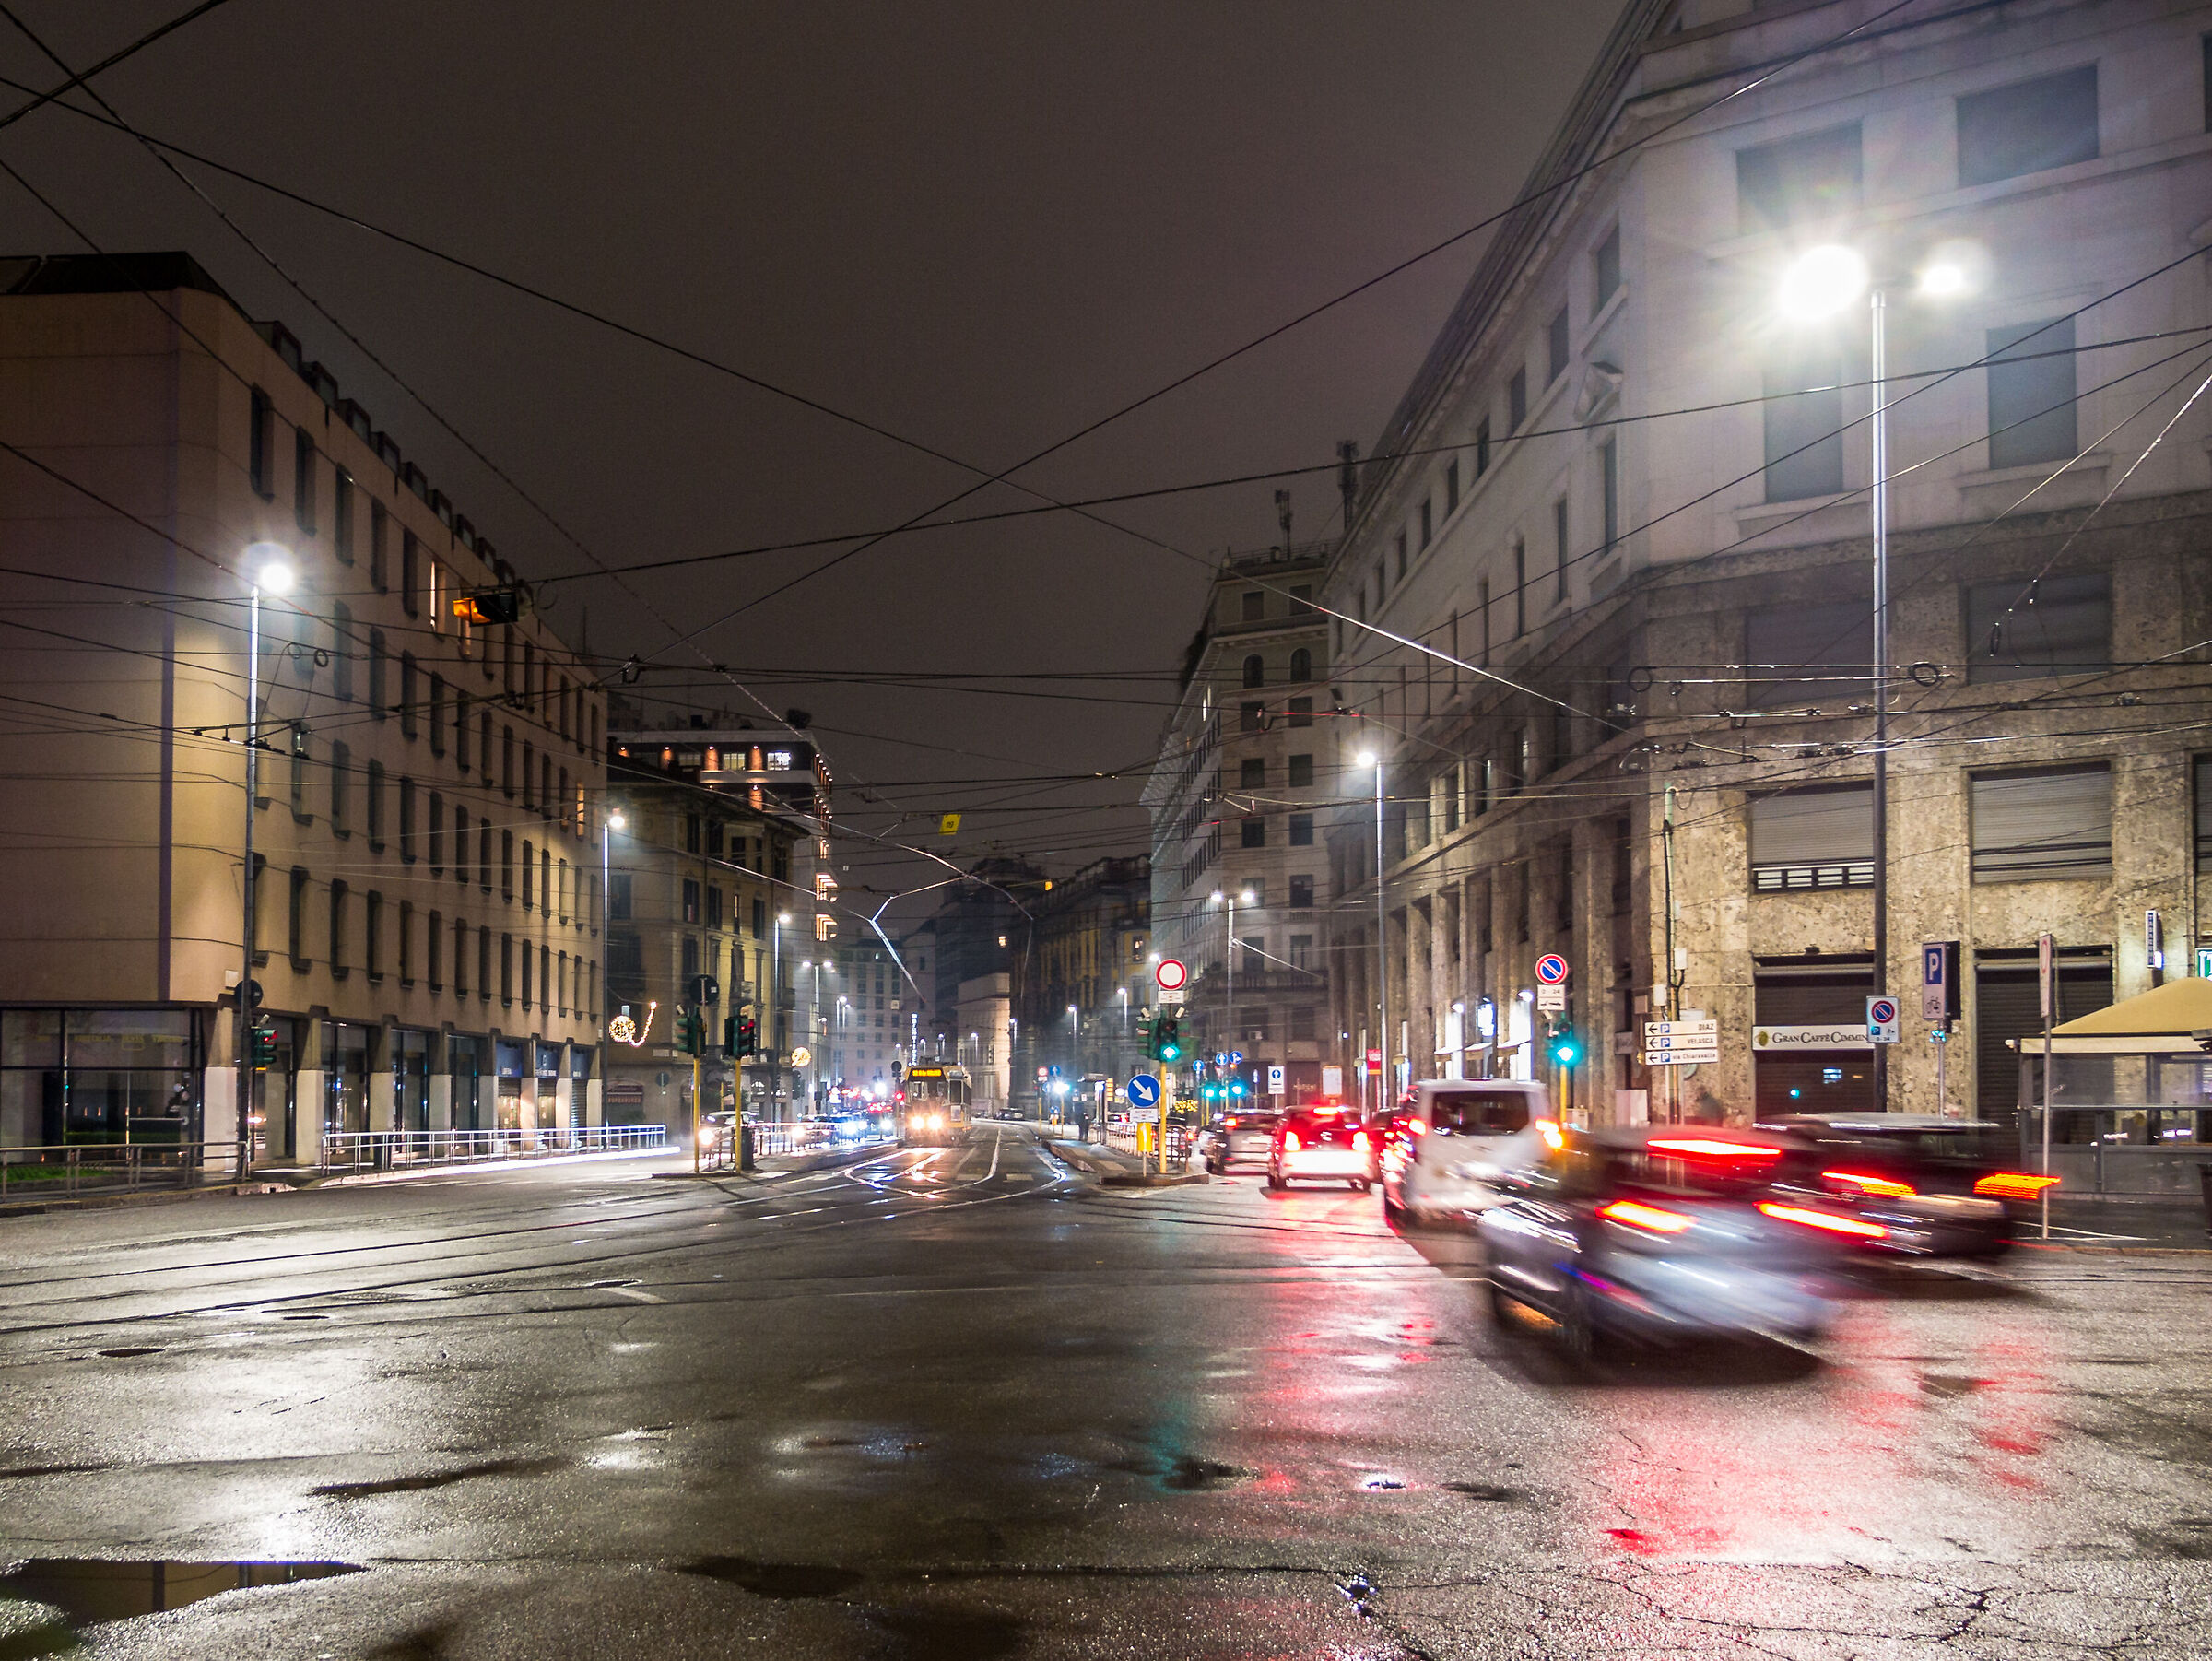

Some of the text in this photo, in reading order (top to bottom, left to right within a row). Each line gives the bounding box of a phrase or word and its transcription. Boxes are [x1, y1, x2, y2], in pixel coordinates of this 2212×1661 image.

[1928, 952, 1939, 981] P
[1772, 1032, 1799, 1043] GRAN
[1830, 1031, 1868, 1043] CIMMIN
